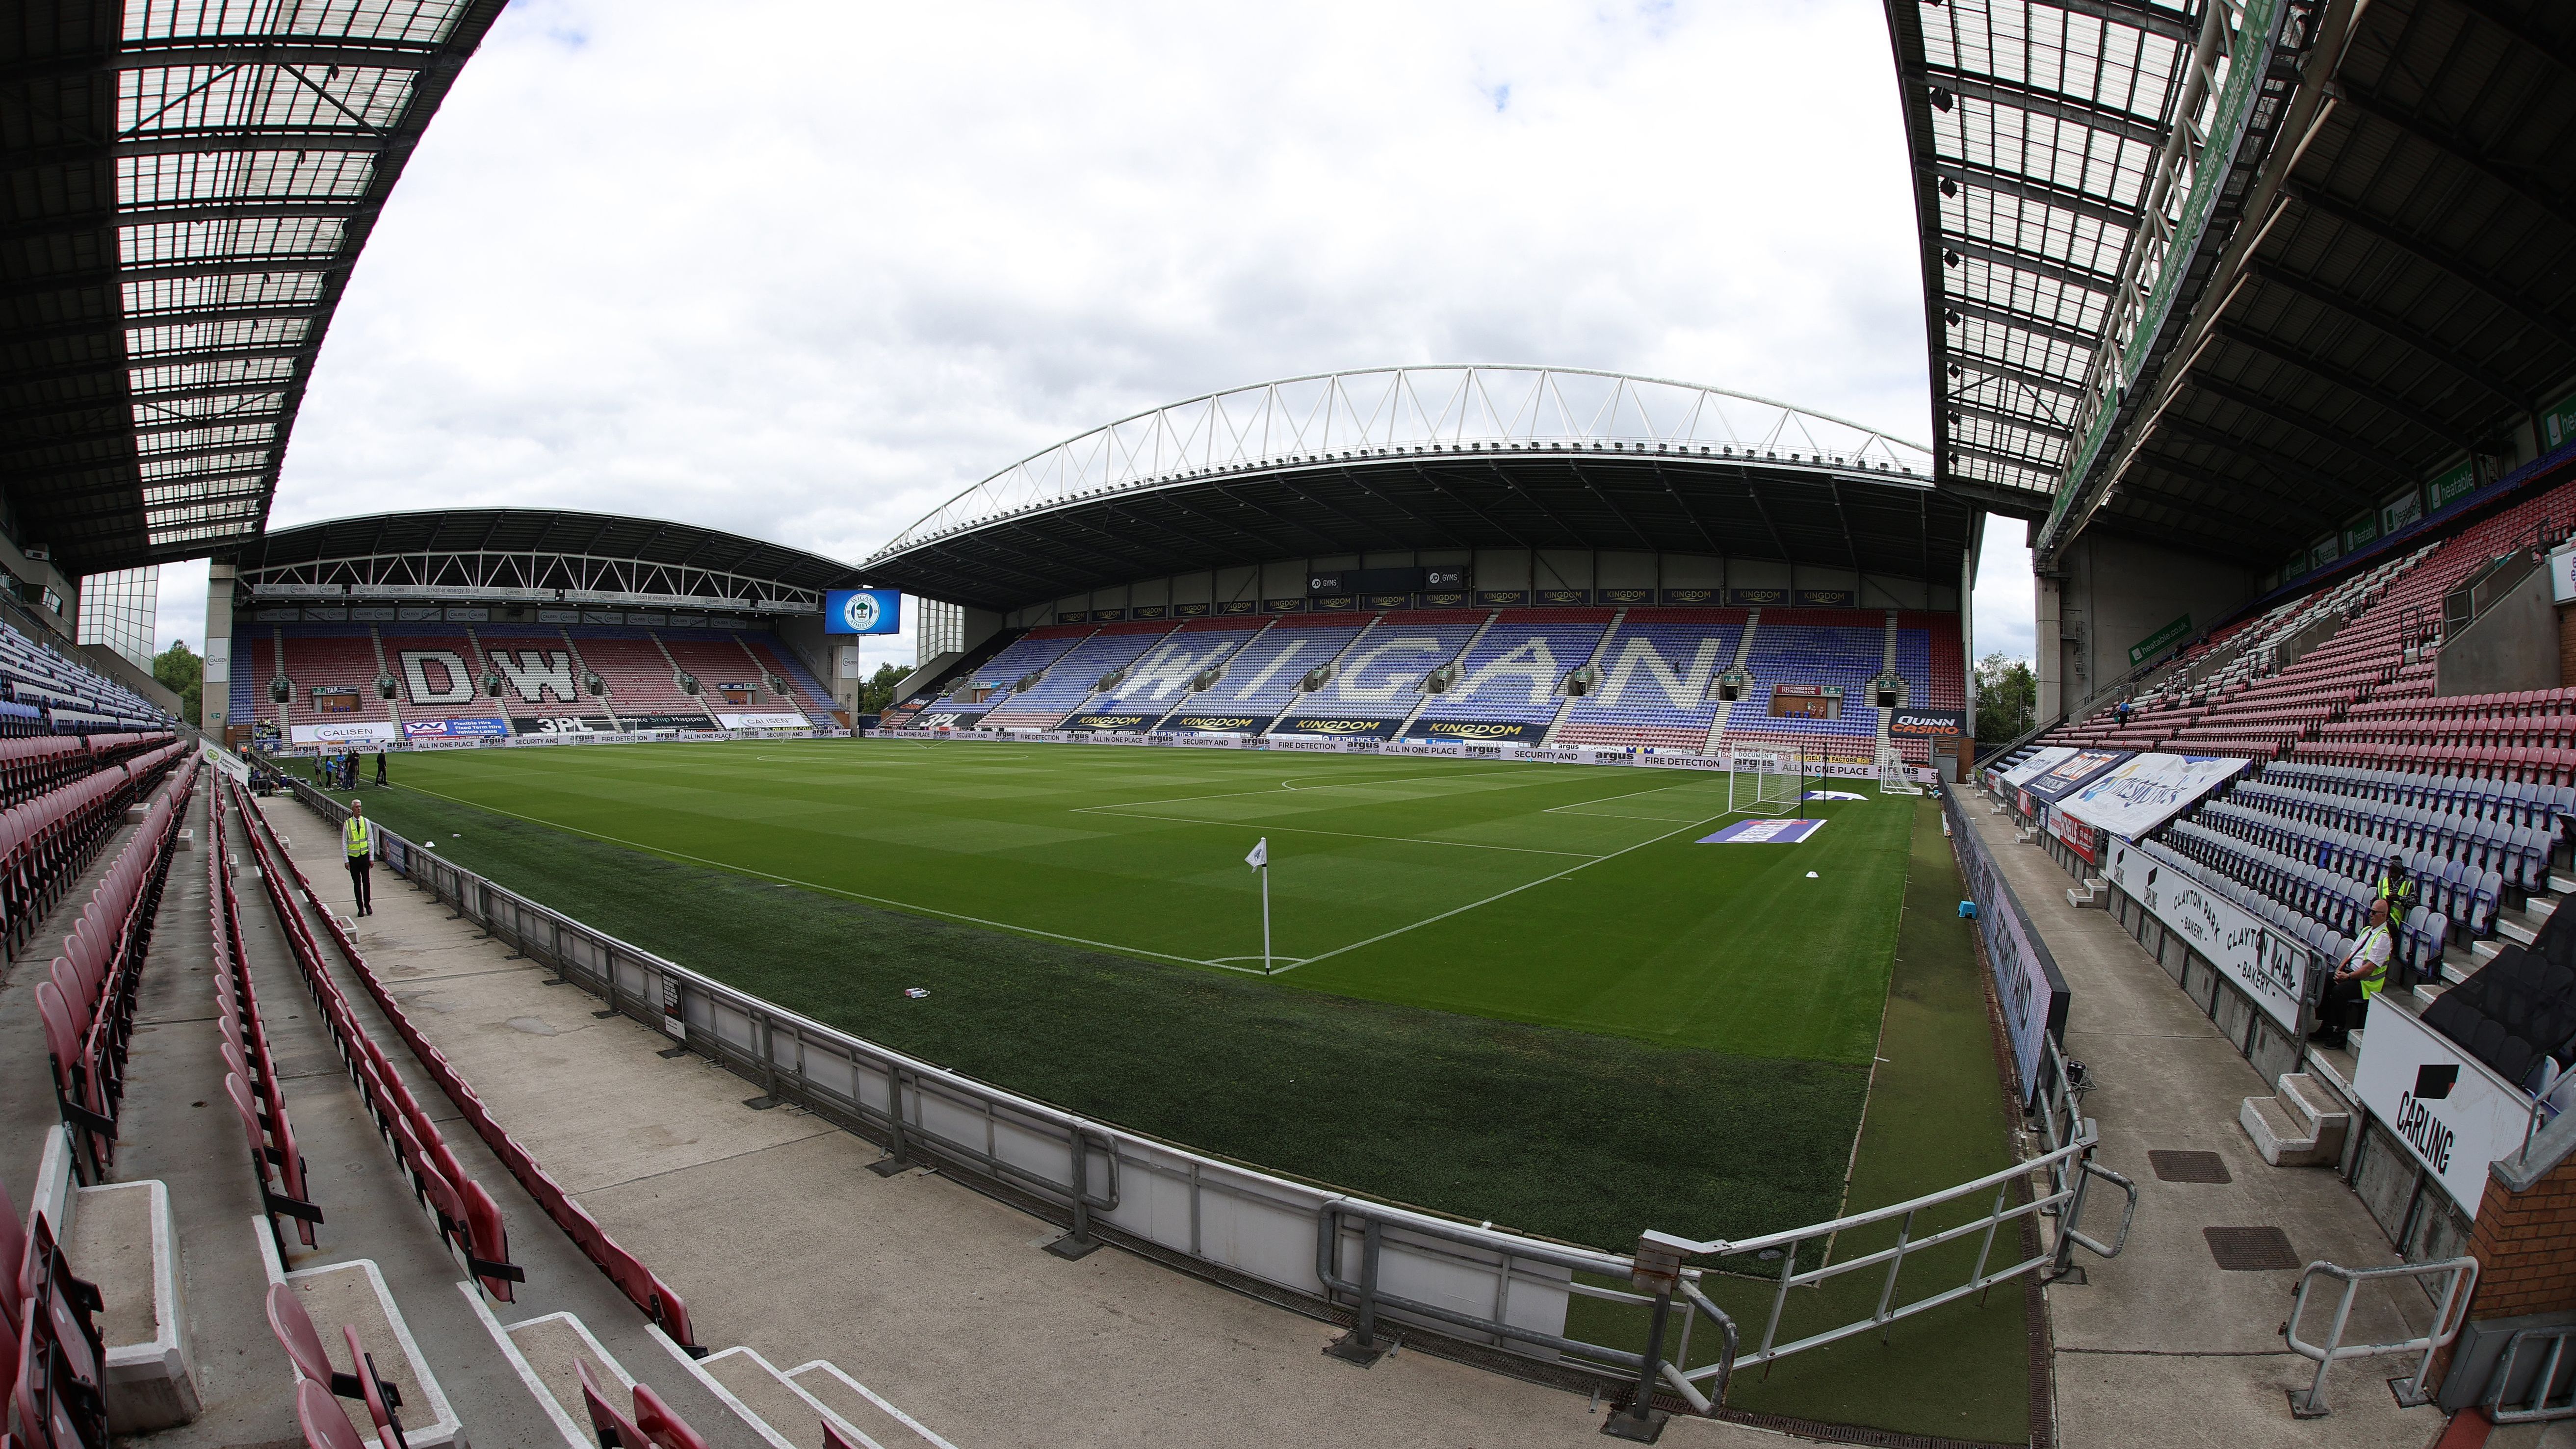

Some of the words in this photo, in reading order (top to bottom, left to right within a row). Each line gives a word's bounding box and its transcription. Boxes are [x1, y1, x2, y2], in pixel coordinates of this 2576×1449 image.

[1442, 574, 1457, 582] GYMS
[851, 595, 873, 603] WIGAN
[1426, 595, 1462, 603] KINGDOM
[1483, 592, 1520, 601] KINGDOM
[1544, 591, 1582, 599] KINGDOM
[1606, 591, 1646, 599] KINGDOM
[1671, 591, 1711, 599] KINGDOM
[1740, 591, 1780, 599] KINGDOM
[1804, 592, 1845, 600] KINGDOM
[1371, 596, 1405, 604] KINGDOM
[1138, 606, 1163, 615] KINGDOM
[1179, 604, 1207, 613] KINGDOM
[850, 619, 873, 628] ATHLETIC
[2140, 621, 2188, 654] heatable.co.uk
[1114, 637, 1722, 706] WIGAN
[920, 713, 962, 726] 3PL
[1078, 716, 1143, 724] KINGDOM
[1179, 718, 1253, 726] KINGDOM
[1897, 716, 1955, 726] QUINN
[537, 718, 594, 732] 3PL
[1296, 720, 1380, 730] KINGDOM
[1429, 723, 1523, 735] KINGDOM
[1891, 724, 1959, 735] CASINO
[293, 746, 320, 754] argus
[1465, 746, 1501, 754] argus
[1514, 750, 1557, 759] SECURITY
[1595, 751, 1634, 760] argus
[220, 760, 233, 772] Projects
[221, 756, 242, 771] Greenmount
[1667, 758, 1720, 767] DETECTION
[1734, 758, 1775, 768] argus
[1815, 765, 1835, 774] ONE
[1838, 766, 1868, 775] PLACE
[2113, 864, 2124, 886] CARLING
[2143, 885, 2158, 911] CARLING
[2173, 889, 2202, 910] CLAYTON
[2203, 900, 2222, 943] PARK
[2184, 916, 2204, 942] BAKERY
[2013, 958, 2032, 1030] AND
[2395, 1090, 2454, 1177] CARLING
